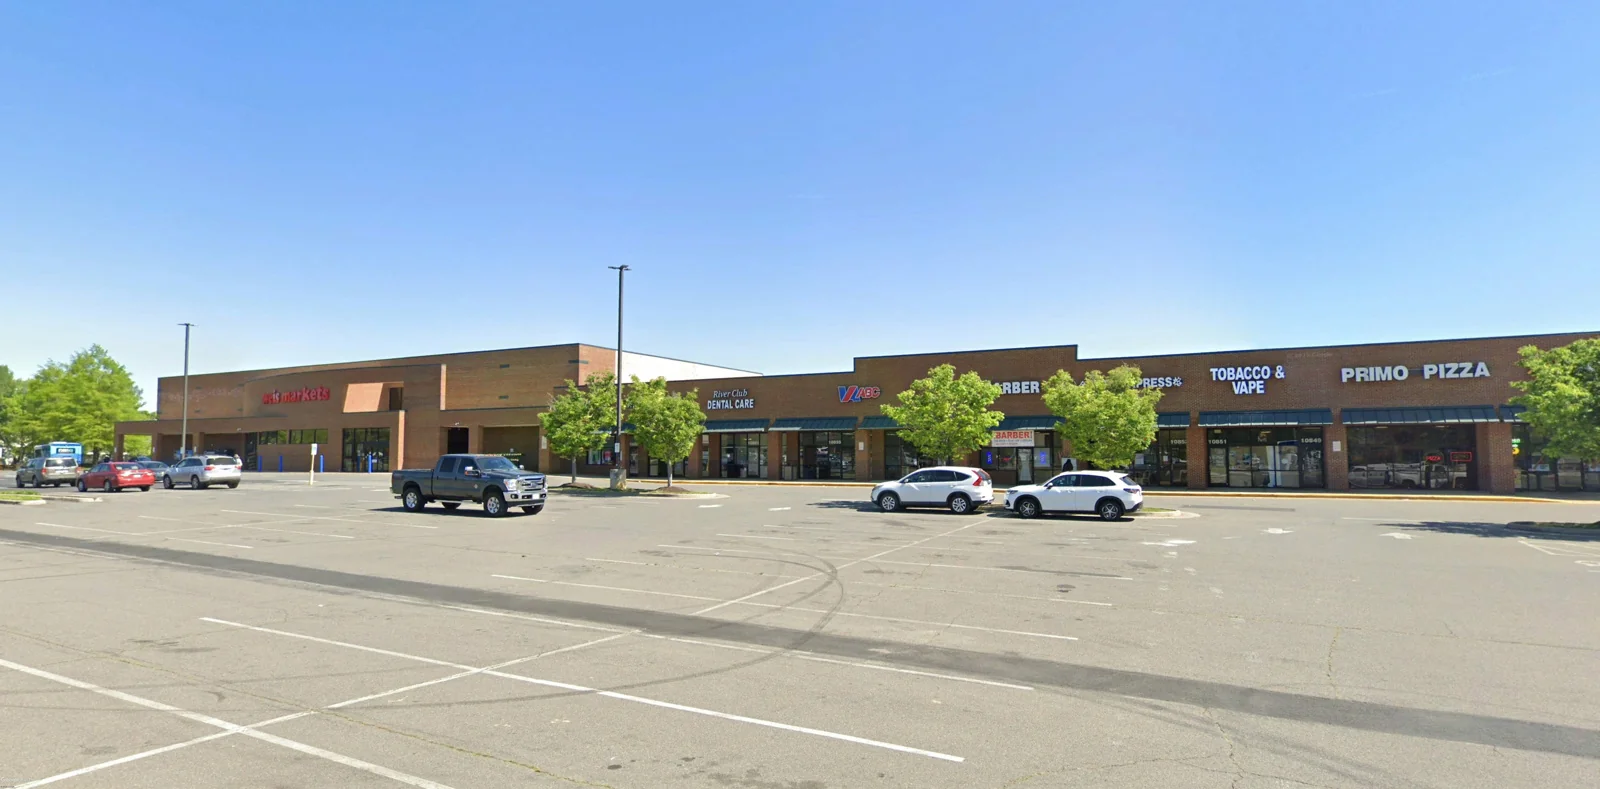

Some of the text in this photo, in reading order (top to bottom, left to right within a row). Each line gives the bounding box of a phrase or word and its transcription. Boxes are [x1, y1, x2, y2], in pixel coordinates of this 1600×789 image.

[1210, 365, 1286, 381] TOBACCO &
[1341, 362, 1491, 382] PRIMO PIZZA
[995, 381, 1040, 394] RBER
[1133, 377, 1172, 388] PRESS
[1232, 380, 1266, 395] VAPE
[281, 386, 331, 403] markets
[713, 389, 748, 398] River Club
[707, 399, 754, 410] DENTAL CARE
